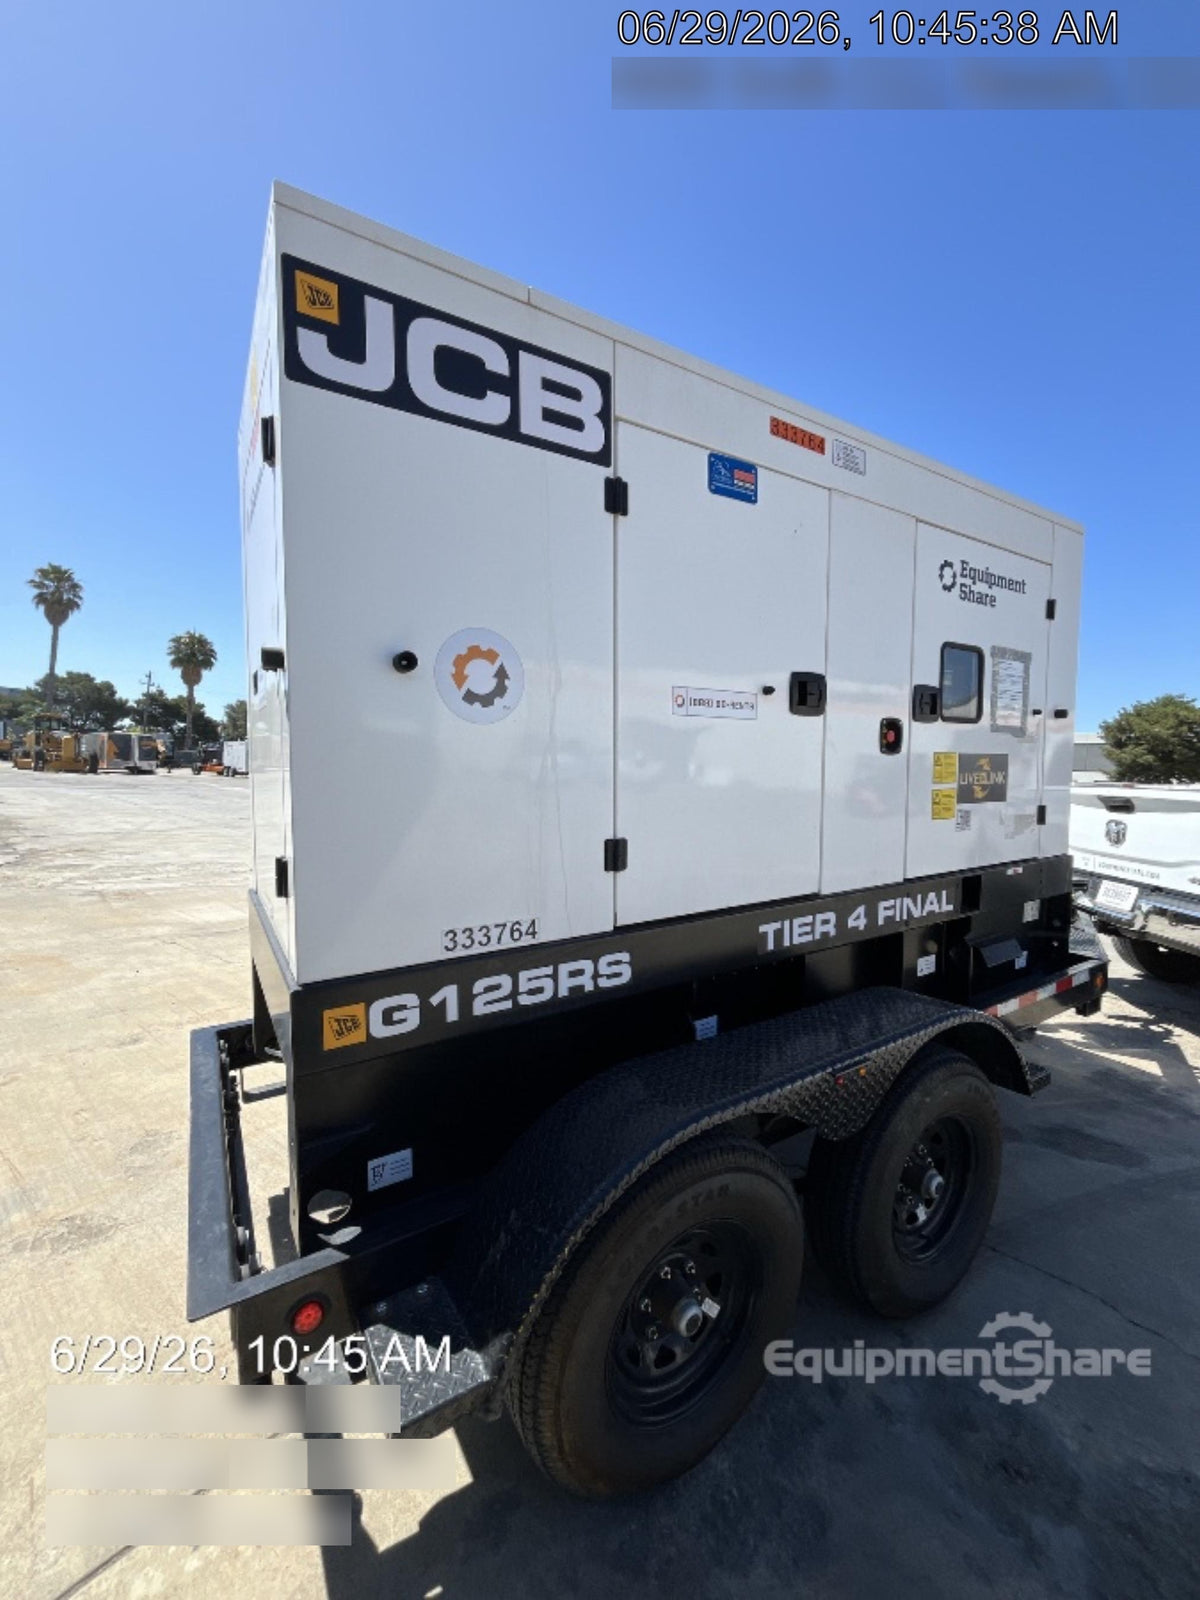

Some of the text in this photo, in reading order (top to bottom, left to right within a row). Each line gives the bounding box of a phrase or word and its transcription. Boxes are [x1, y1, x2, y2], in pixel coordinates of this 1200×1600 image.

[296, 294, 605, 453] JCB
[959, 583, 997, 608] Share
[960, 560, 1027, 595] Equipment
[444, 919, 538, 951] 333764
[759, 889, 954, 951] TIER 4 FINAL
[369, 951, 633, 1040] G125RS
